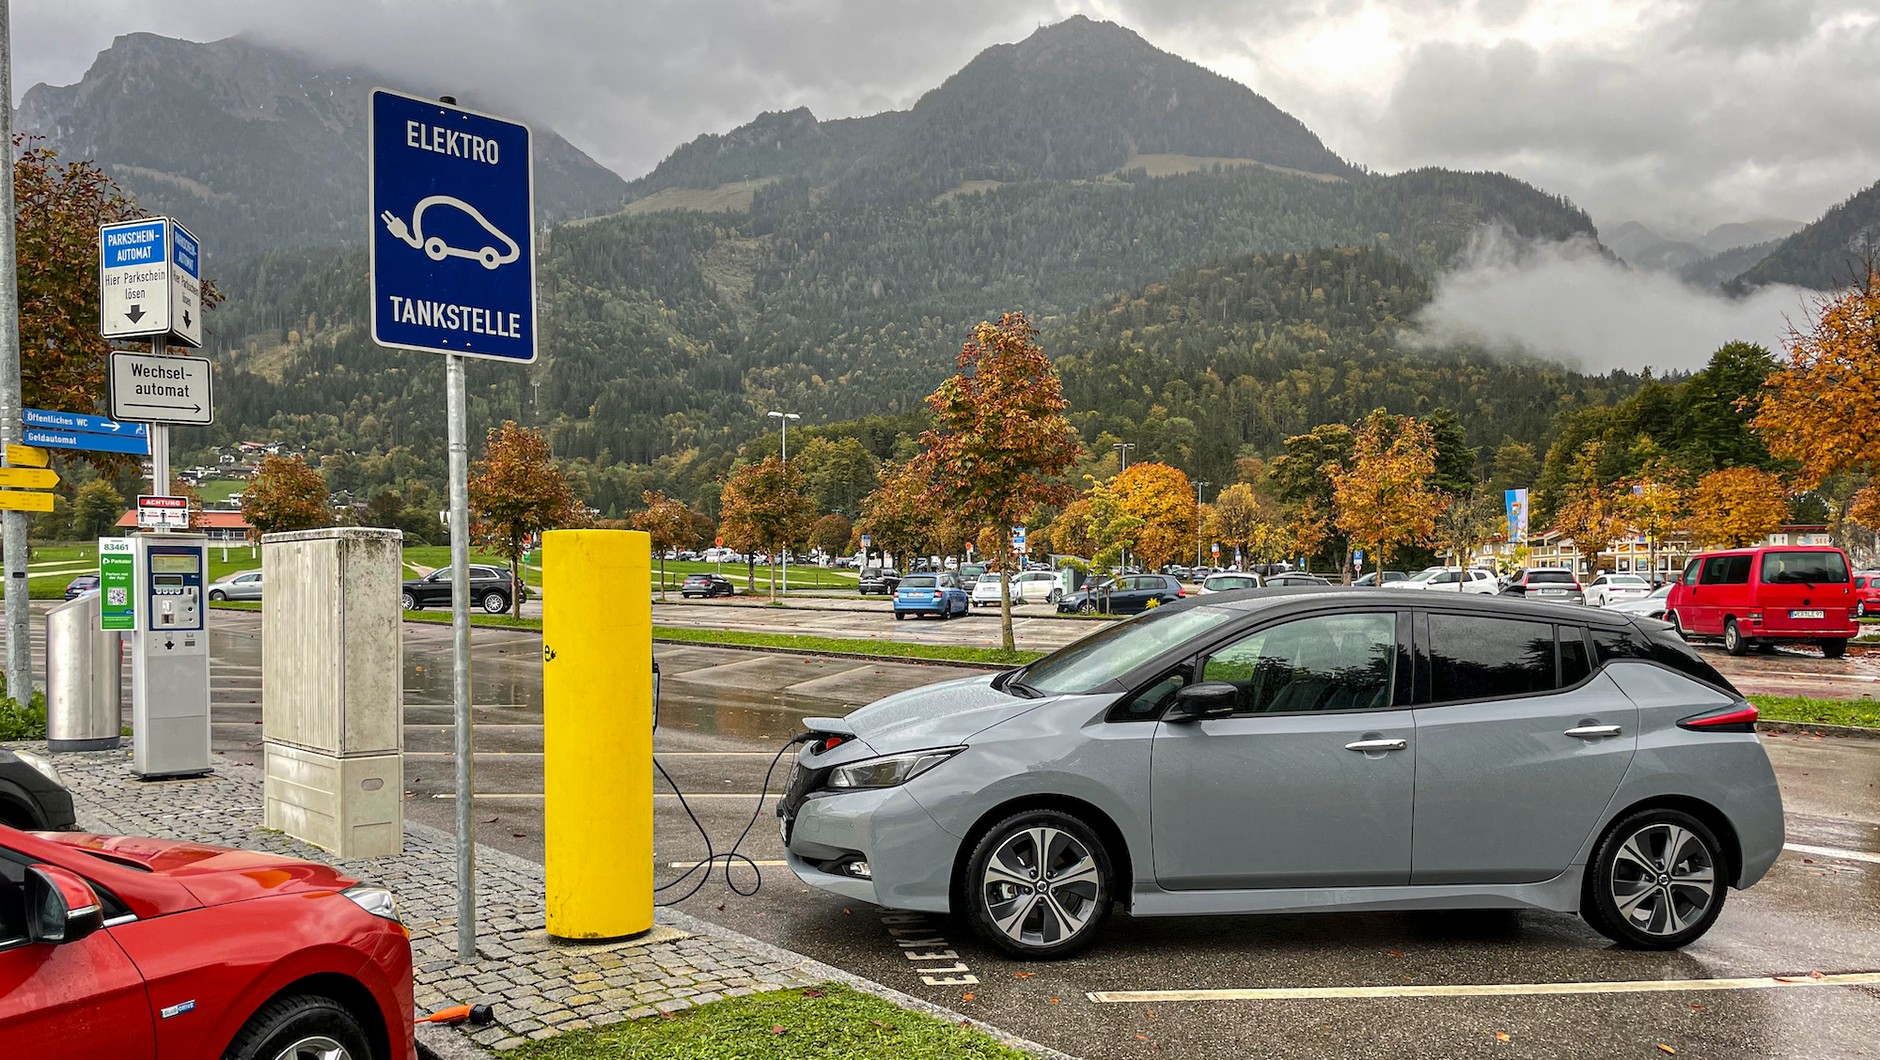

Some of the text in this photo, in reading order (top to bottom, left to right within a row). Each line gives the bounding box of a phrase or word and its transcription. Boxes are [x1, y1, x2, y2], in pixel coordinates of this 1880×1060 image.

[406, 119, 499, 165] ELEKTRO
[108, 229, 160, 247] PARKSCHEIN-
[117, 246, 152, 262] AUTOMAT
[105, 268, 166, 286] Hier Parkschein
[125, 288, 146, 300] lösen
[389, 295, 521, 339] TANKSTELLE
[131, 363, 192, 380] Wechsel-
[135, 382, 190, 398] automat
[27, 410, 88, 427] Öffentliches WC
[28, 432, 77, 445] Geldautomat
[104, 543, 129, 551] 83461
